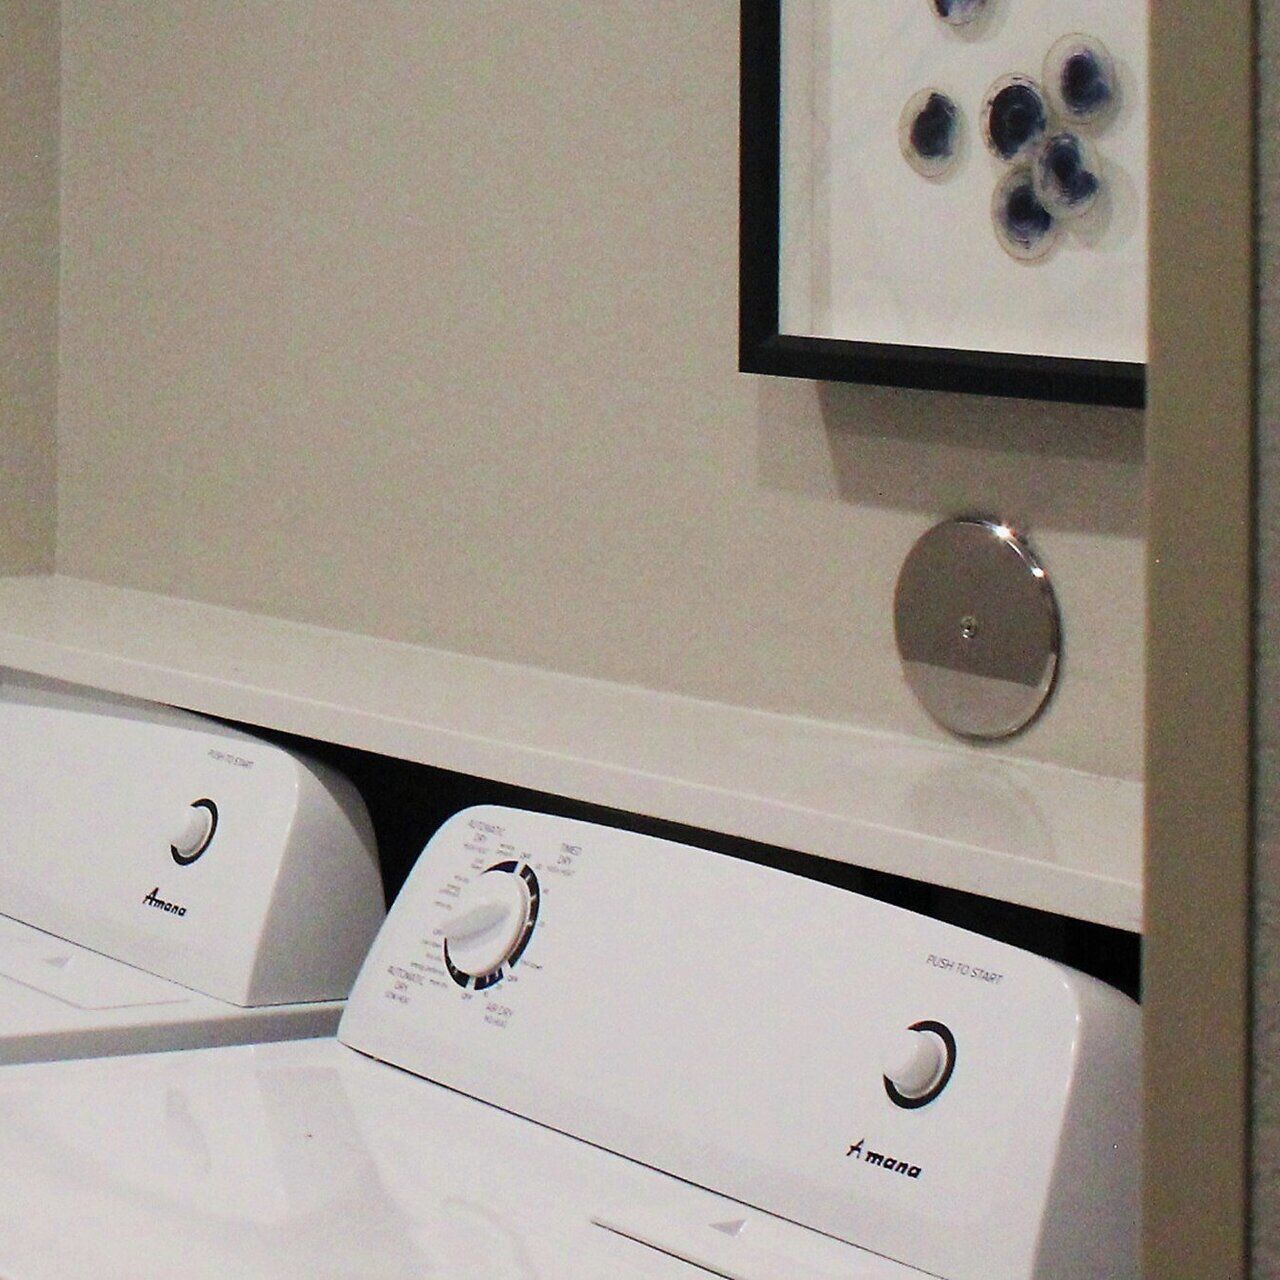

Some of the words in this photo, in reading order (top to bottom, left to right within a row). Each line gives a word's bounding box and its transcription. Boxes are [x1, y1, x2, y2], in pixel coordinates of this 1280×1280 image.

[142, 887, 187, 916] Amana
[926, 953, 955, 970] PUSH
[956, 962, 970, 976] TO
[970, 967, 1004, 985] START
[845, 1137, 922, 1179] Amana
